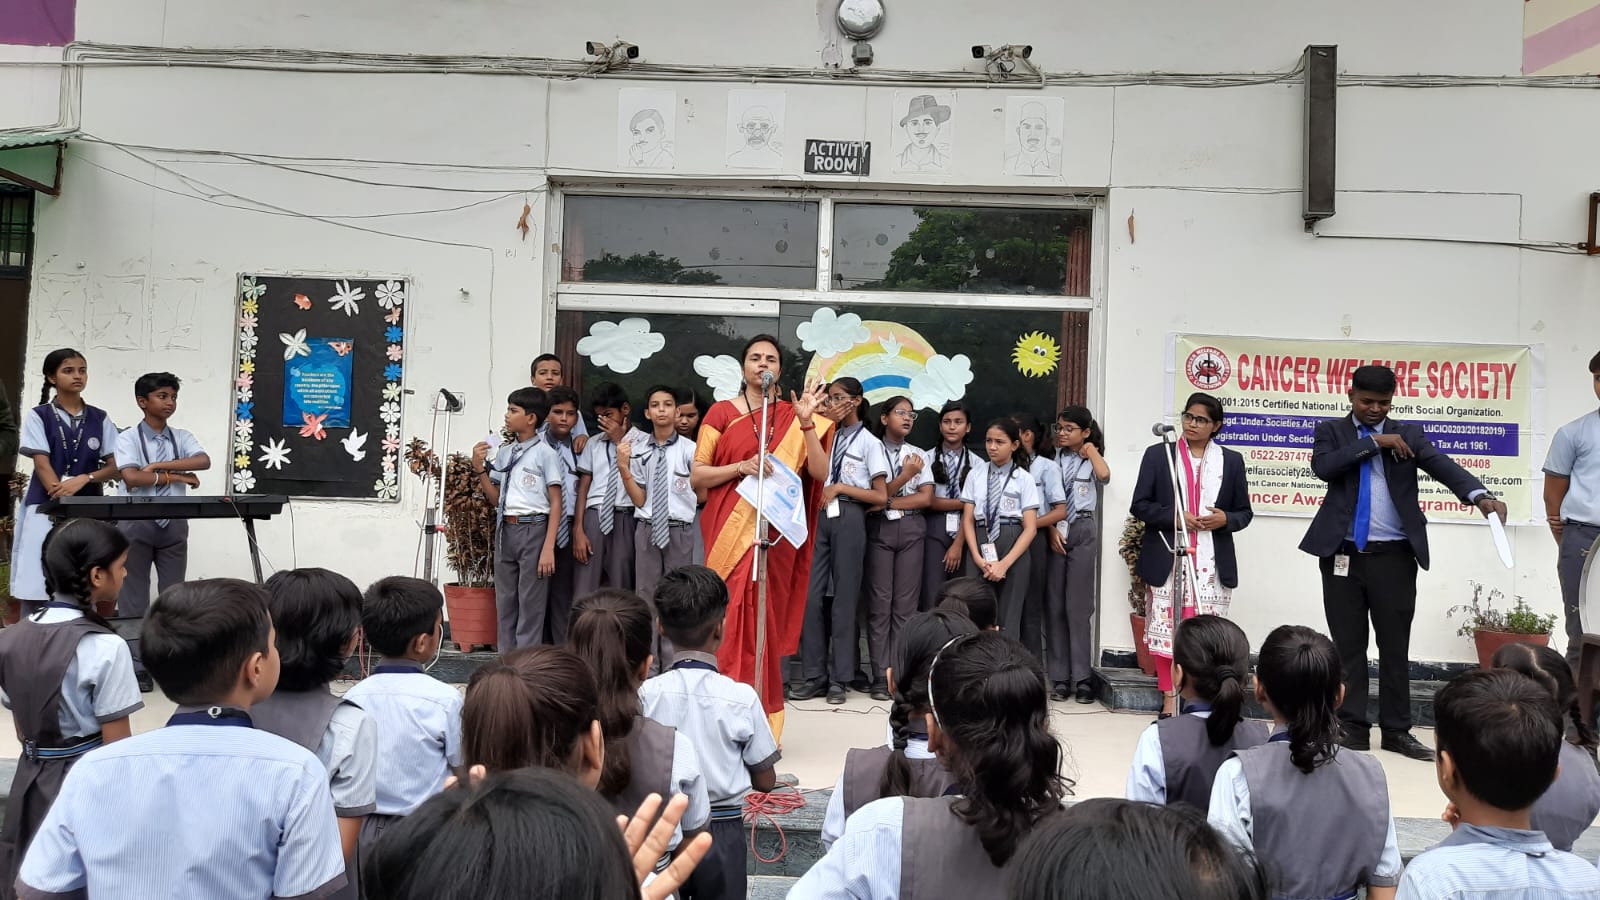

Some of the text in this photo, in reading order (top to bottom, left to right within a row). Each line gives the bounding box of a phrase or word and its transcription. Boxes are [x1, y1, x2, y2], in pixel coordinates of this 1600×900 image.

[808, 142, 869, 157] ACTIVITY
[814, 156, 857, 171] ROOM
[1237, 353, 1517, 400] CANCER WERE SOCIETY
[1262, 399, 1300, 410] Certified
[1302, 401, 1338, 411] National
[1390, 404, 1503, 418] Profit Social Organization.
[1240, 416, 1264, 426] Under
[1265, 418, 1300, 428] Societies
[1216, 431, 1315, 444] egistration Under Sectio
[1437, 440, 1451, 449] Tax
[1453, 441, 1468, 450] Act
[1470, 441, 1492, 451] 1961.
[1250, 449, 1313, 462] 0522-297476
[1261, 480, 1289, 488] Cancer
